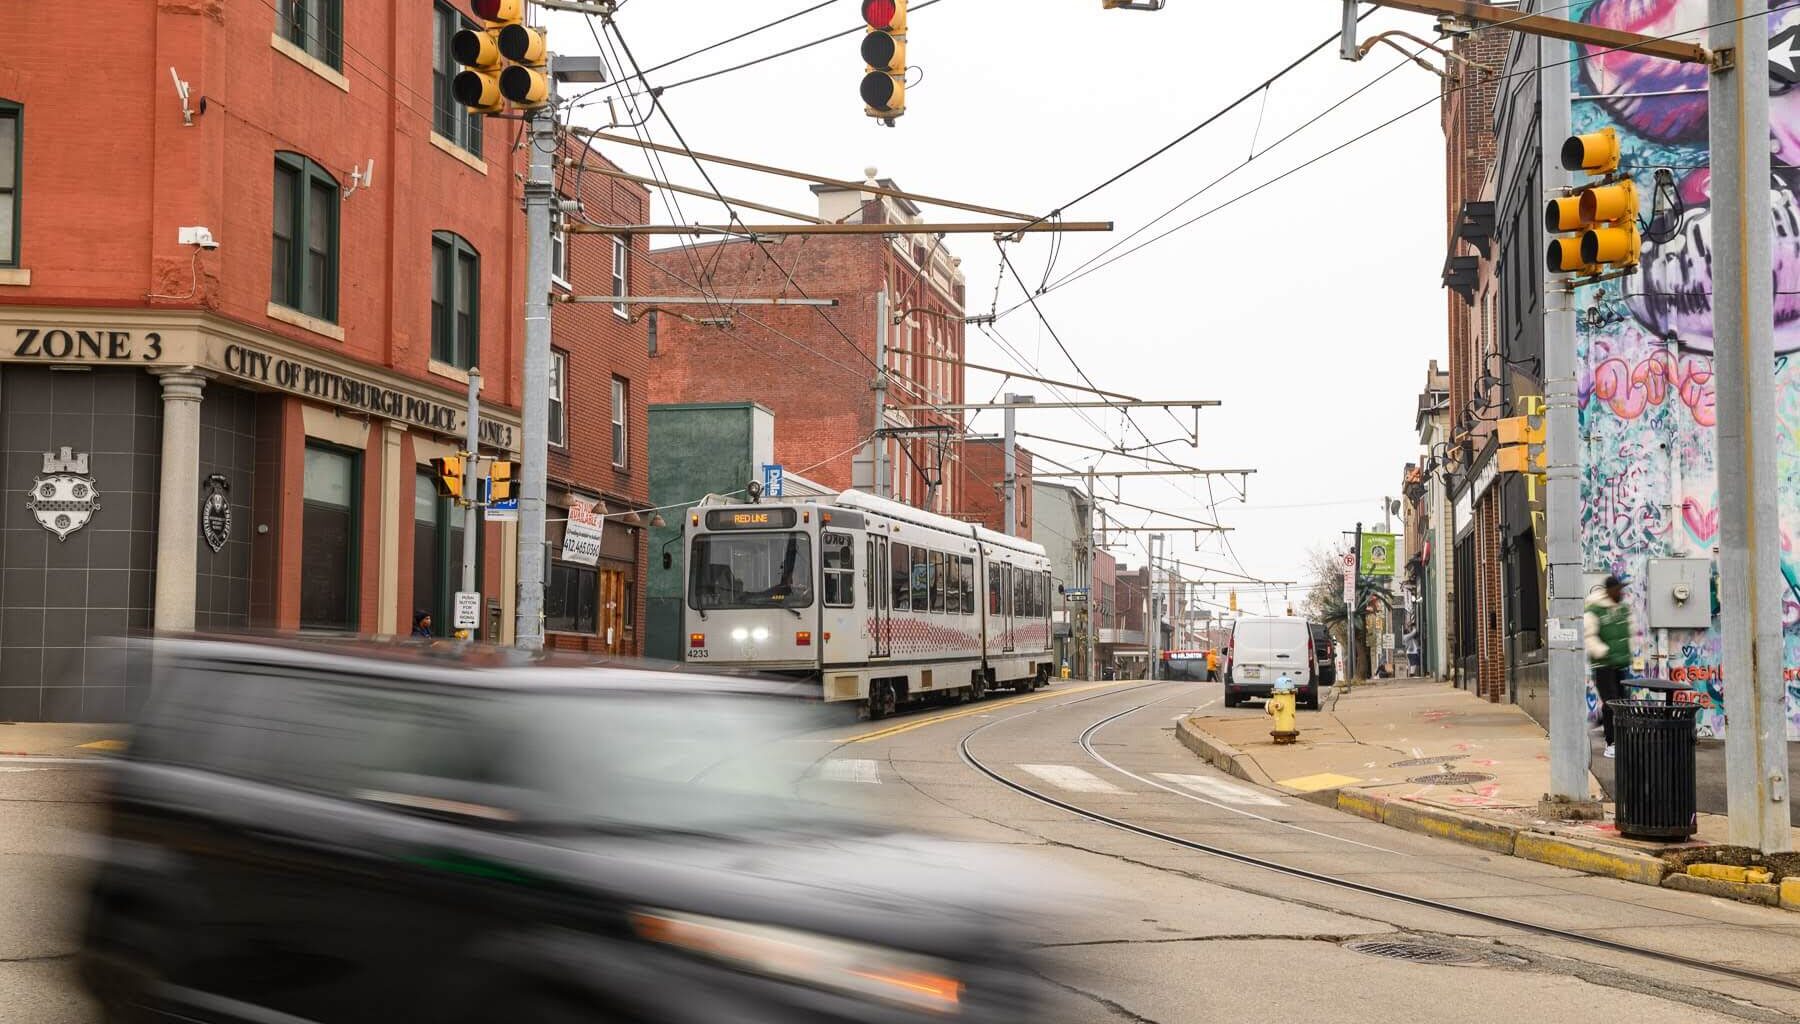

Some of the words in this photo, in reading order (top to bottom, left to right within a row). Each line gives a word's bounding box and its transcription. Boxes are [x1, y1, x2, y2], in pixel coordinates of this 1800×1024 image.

[14, 328, 131, 359] ZONE
[143, 332, 162, 360] 3
[225, 344, 273, 380] CITY
[276, 359, 302, 388] OF
[304, 366, 404, 418] PITTSBURGH
[405, 396, 457, 431] POLICE
[478, 416, 504, 445] ONE
[505, 426, 512, 449] 3
[734, 513, 751, 524] RED
[751, 512, 768, 523] LINE
[688, 649, 709, 658] 4233
